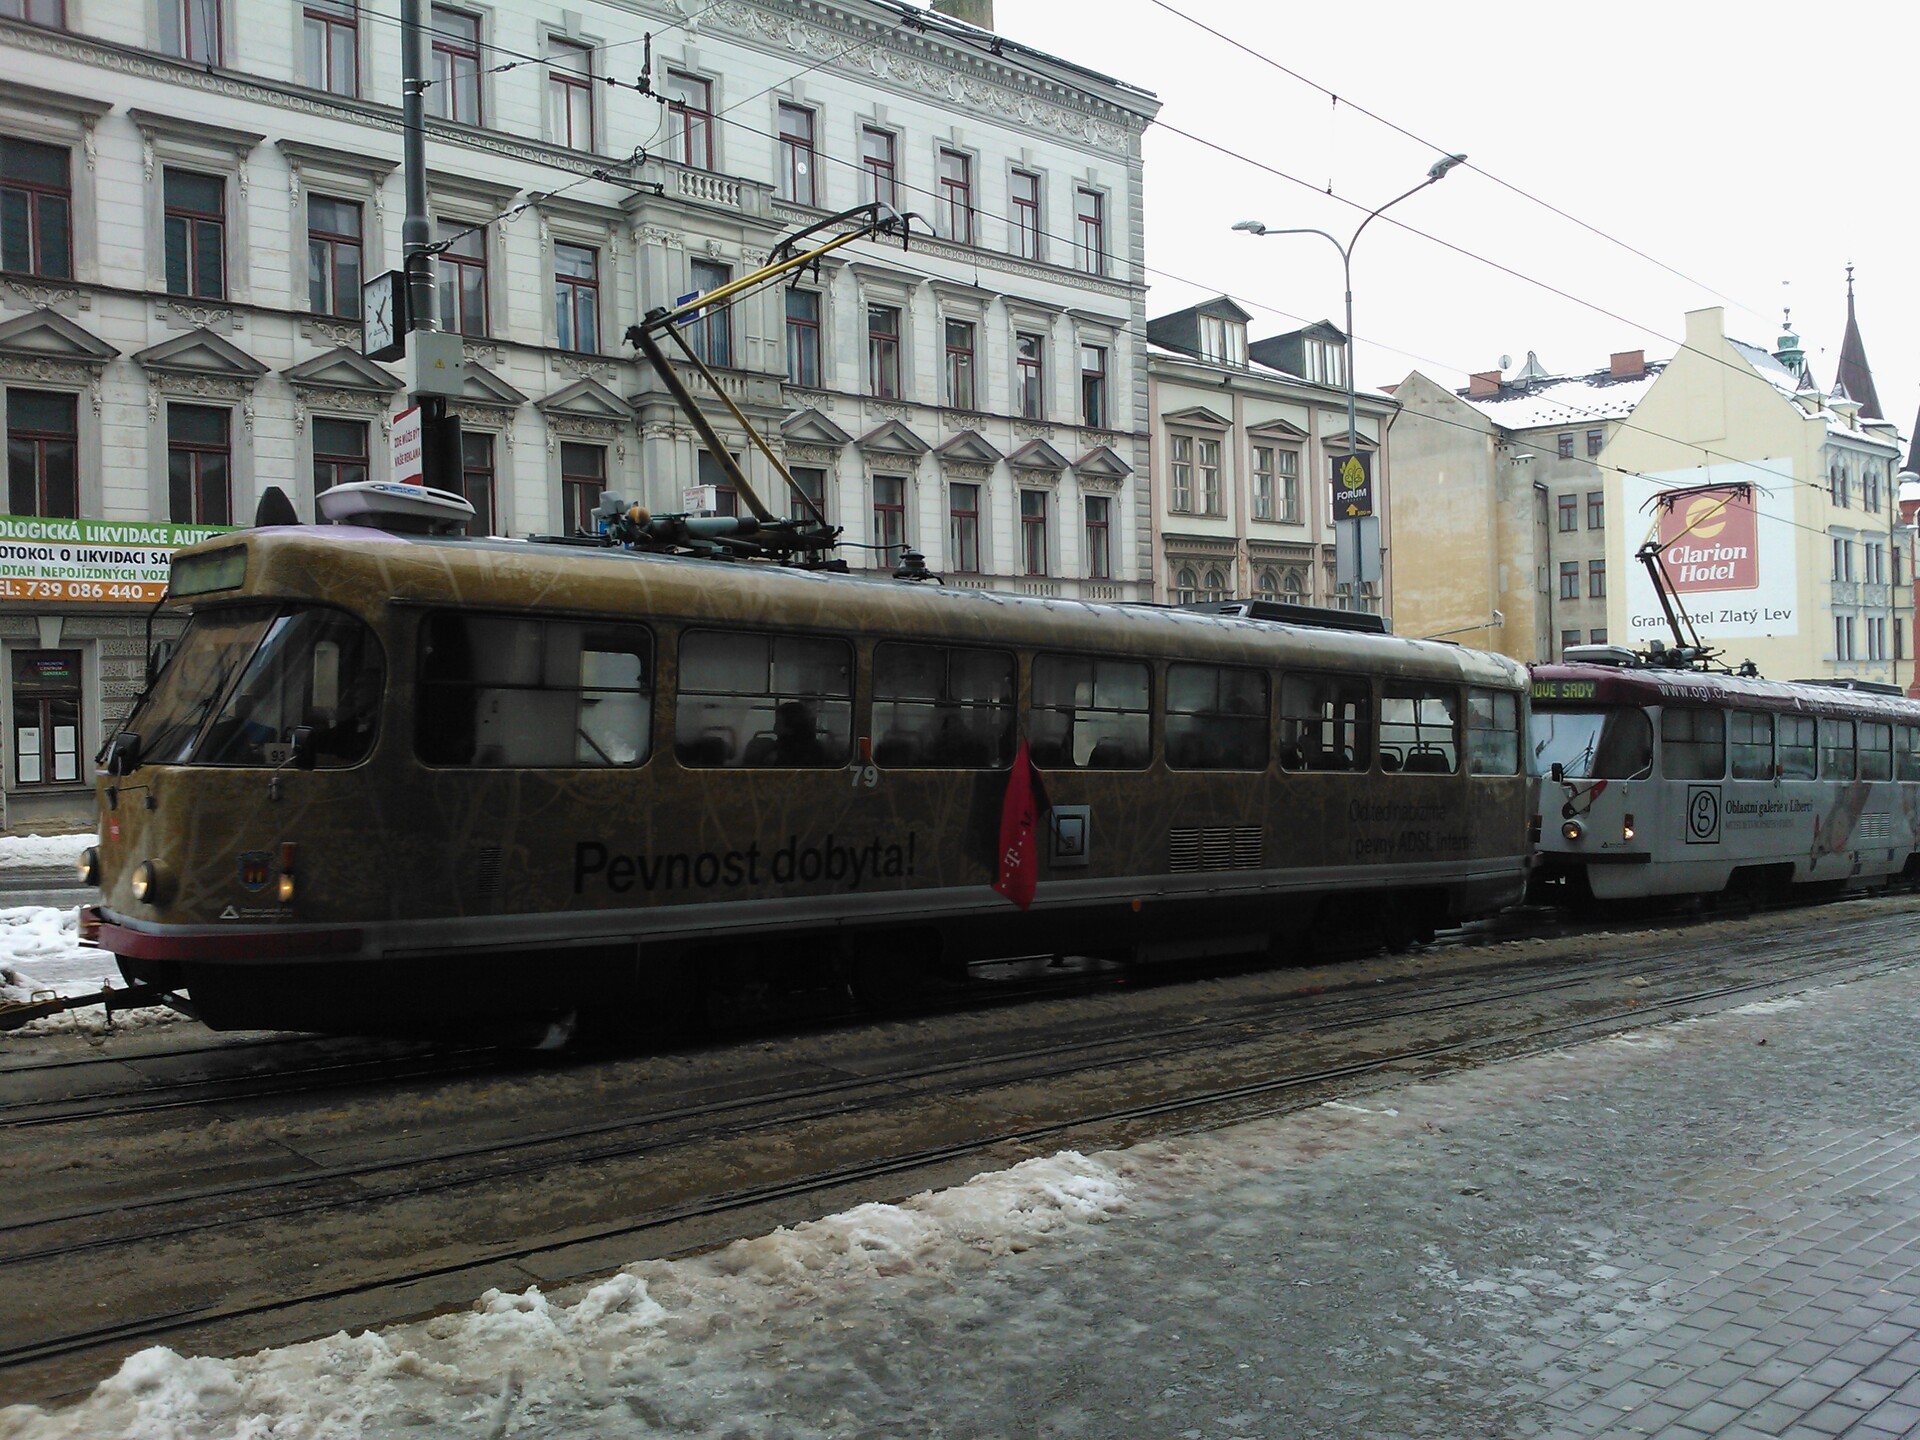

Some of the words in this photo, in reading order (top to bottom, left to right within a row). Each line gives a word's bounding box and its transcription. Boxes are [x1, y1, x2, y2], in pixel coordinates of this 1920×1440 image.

[1336, 488, 1367, 500] FORUM
[0, 521, 81, 540] OLOGICKÁ
[86, 526, 168, 545] LIKVIDACE
[0, 546, 55, 560] OTOKOL
[60, 549, 71, 561] O
[77, 550, 145, 564] LIKVIDACI
[1668, 543, 1747, 564] Clarion
[0, 564, 35, 576] DTAH
[41, 565, 136, 580] NEPOJÍZDNÝCH
[1680, 562, 1735, 582] Hotel
[27, 582, 62, 596] 739
[68, 583, 103, 598] 086
[108, 585, 143, 598] 440
[1720, 609, 1757, 624] Zlatý
[1764, 608, 1792, 620] Lev
[1562, 683, 1595, 698] SADY
[1658, 684, 1728, 702] www.ogl.cz
[849, 765, 878, 788] 79
[1758, 800, 1783, 817] galerie
[1398, 831, 1433, 853] ADSL
[574, 841, 760, 893] Pevnost
[772, 832, 916, 890] dobyta!
